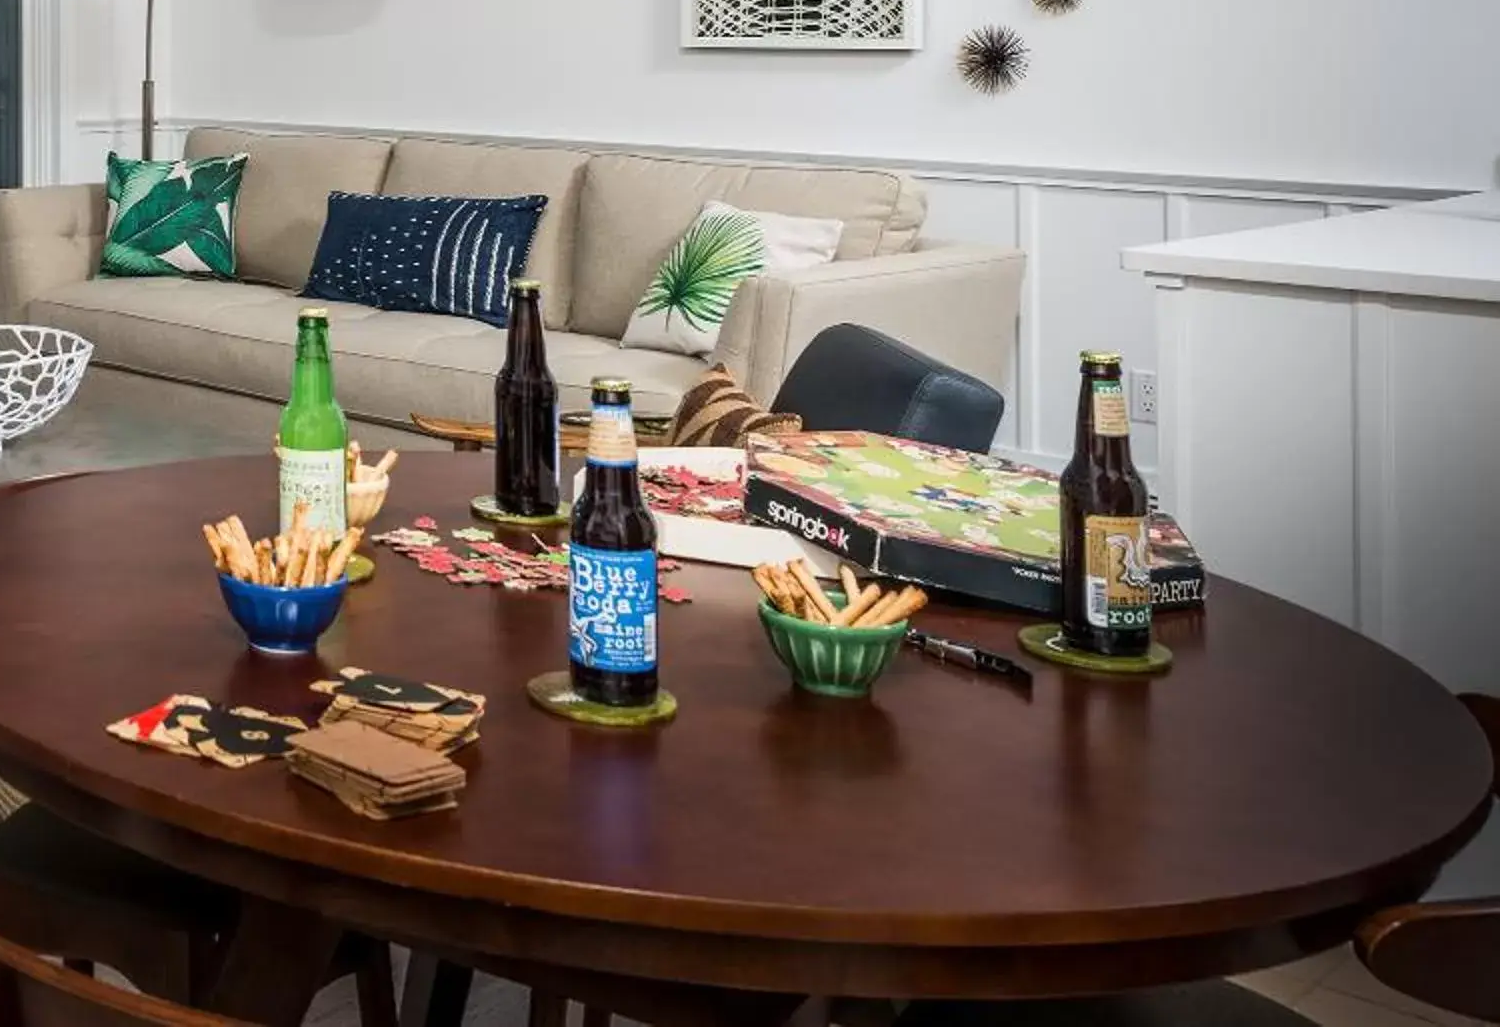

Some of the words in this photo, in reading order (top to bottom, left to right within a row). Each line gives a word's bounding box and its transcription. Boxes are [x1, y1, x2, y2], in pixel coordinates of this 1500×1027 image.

[767, 500, 849, 551] springbok
[572, 554, 637, 592] Blue
[575, 591, 633, 614] soda
[1150, 577, 1201, 604] PARTY
[604, 637, 643, 650] root
